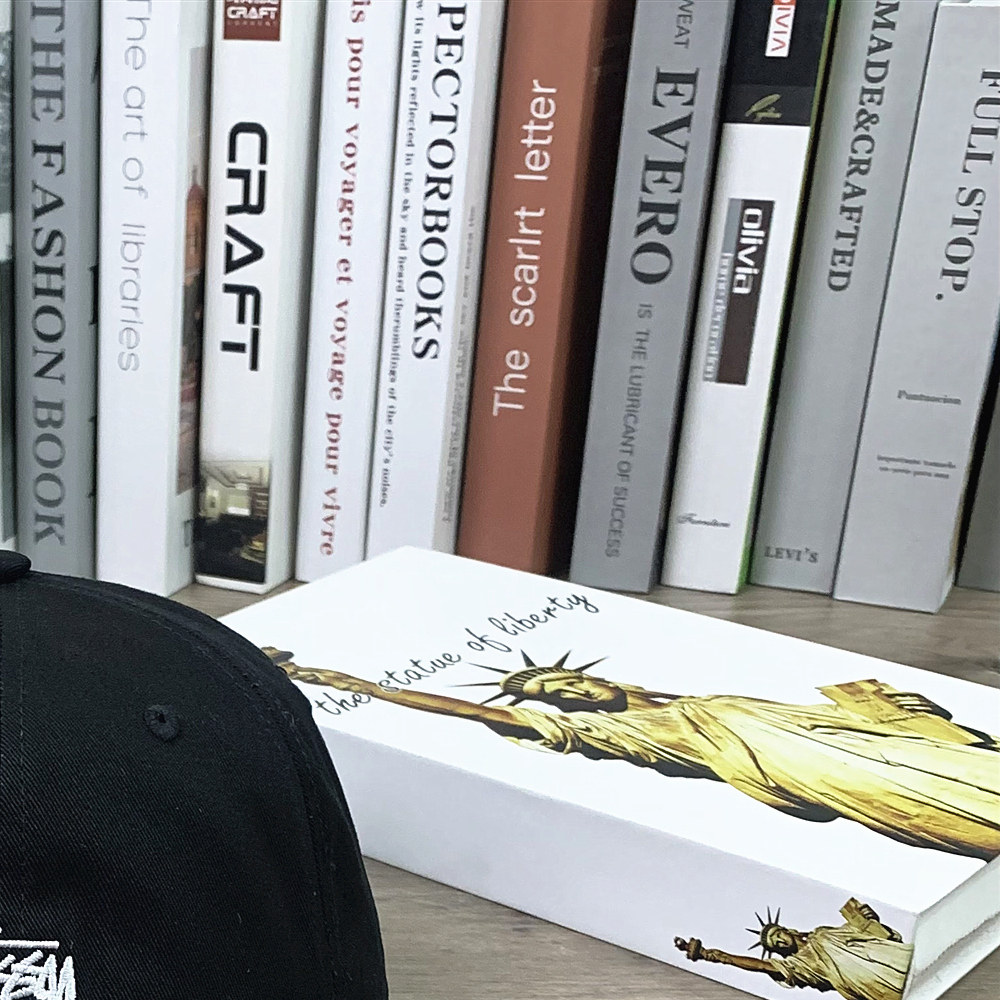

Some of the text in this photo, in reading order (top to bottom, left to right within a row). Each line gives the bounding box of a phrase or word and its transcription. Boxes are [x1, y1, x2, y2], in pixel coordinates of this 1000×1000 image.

[30, 0, 66, 121] THE
[226, 6, 278, 19] CRAFT
[411, 40, 423, 81] lights
[123, 86, 149, 141] art
[346, 37, 364, 109] pour
[405, 87, 418, 147] reflected
[121, 157, 149, 200] of
[335, 123, 359, 247] voyager
[403, 172, 413, 193] the
[411, 3, 467, 360] PECTORBOOKS
[630, 66, 700, 285] EVERO
[828, 1, 900, 293] MADE&CRAFTED
[220, 121, 269, 372] CRAFT
[337, 258, 352, 286] et
[493, 79, 557, 416] The scarlrt letter
[732, 208, 765, 294] olivia
[935, 186, 986, 301] STOP.
[117, 223, 147, 373] libraries
[326, 298, 350, 400] voyage
[31, 398, 66, 546] BOOK
[324, 410, 343, 474] pour
[605, 303, 653, 558] IS THE LUBRICANT OF SUCCESS
[318, 485, 340, 557] vivre
[764, 545, 819, 563] LEVI'S
[315, 591, 600, 716] the statue of liberty
